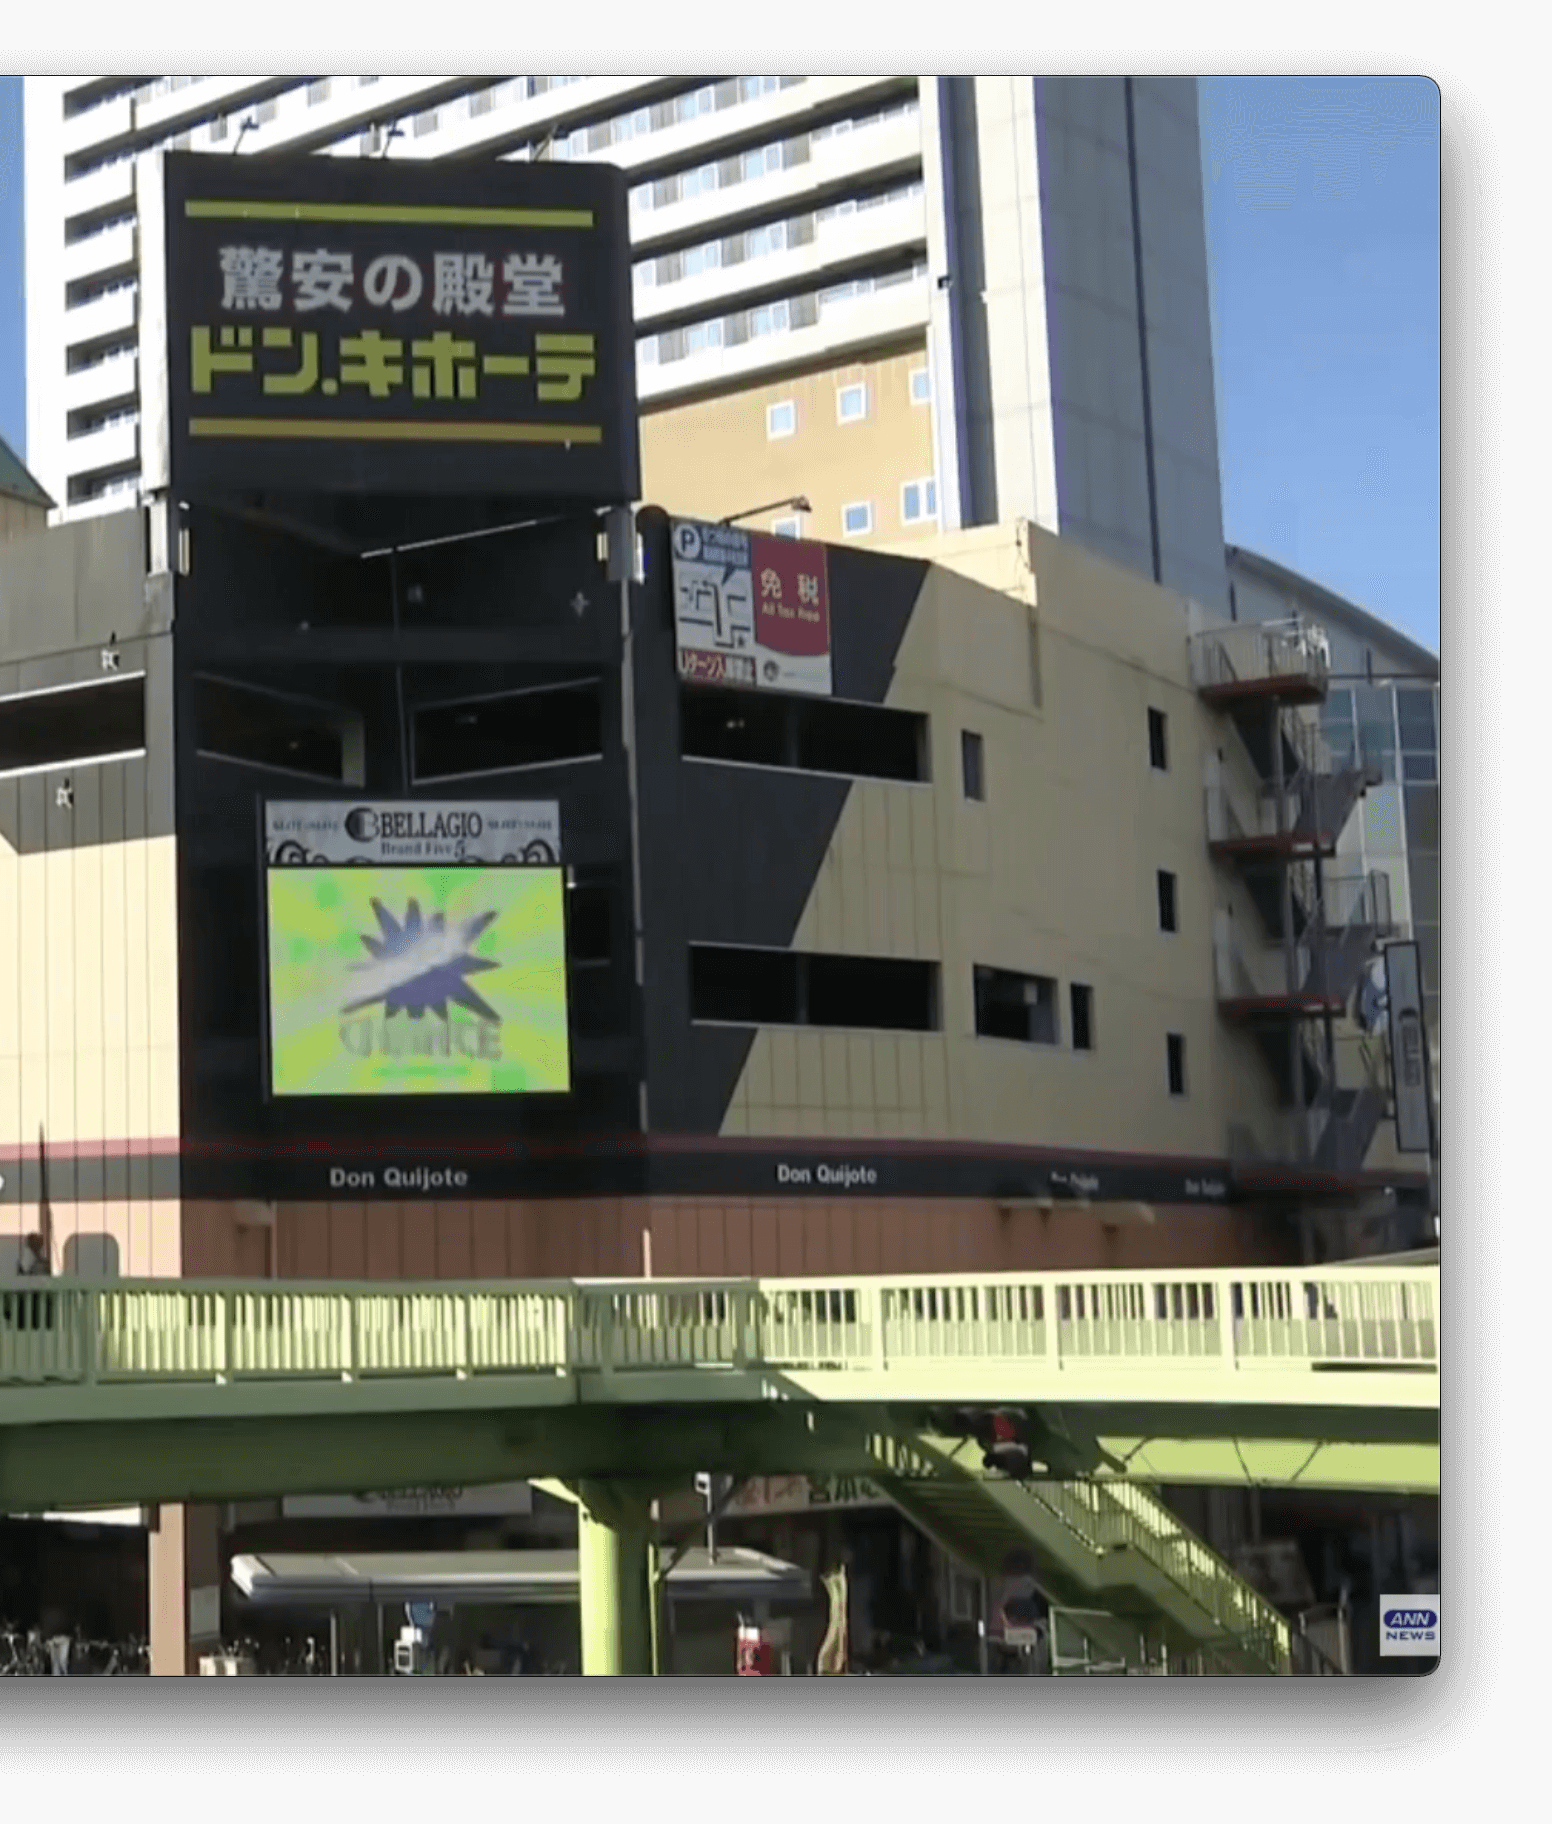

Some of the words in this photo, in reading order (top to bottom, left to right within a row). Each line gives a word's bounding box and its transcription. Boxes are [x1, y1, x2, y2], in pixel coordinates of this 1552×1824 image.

[219, 247, 565, 316] 驚安の殿堂
[681, 528, 695, 553] P
[380, 811, 482, 839] BELLAGIO
[329, 1167, 376, 1188] Don
[383, 1166, 468, 1192] Quijote
[777, 1164, 811, 1184] Don
[817, 1164, 878, 1189] Quijote
